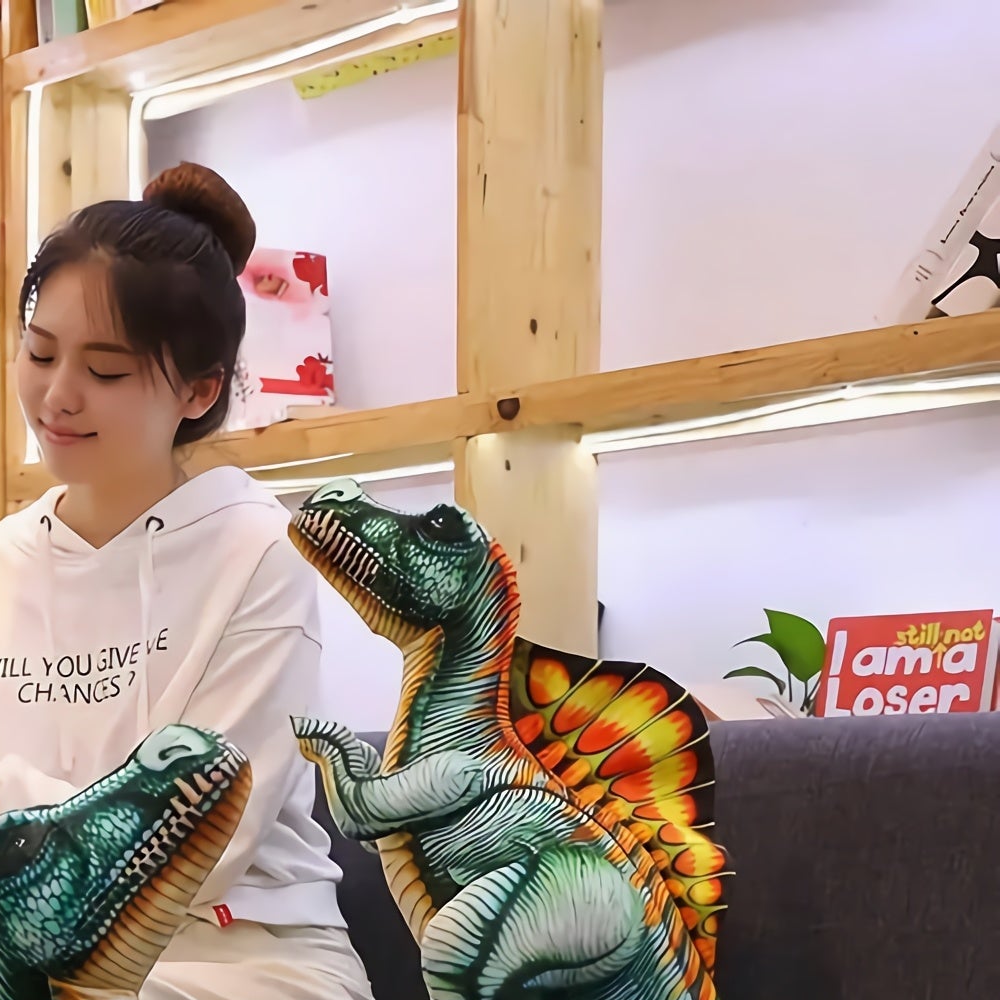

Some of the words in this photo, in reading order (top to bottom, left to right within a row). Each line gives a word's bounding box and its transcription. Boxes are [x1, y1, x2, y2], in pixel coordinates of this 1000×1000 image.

[894, 622, 941, 646] still
[944, 620, 986, 642] not
[42, 654, 93, 678] YOU
[96, 642, 141, 672] GIVE
[829, 630, 848, 676] I
[852, 645, 934, 676] am
[942, 643, 978, 674] a
[18, 675, 121, 704] CHANCES
[824, 677, 971, 717] Loser
